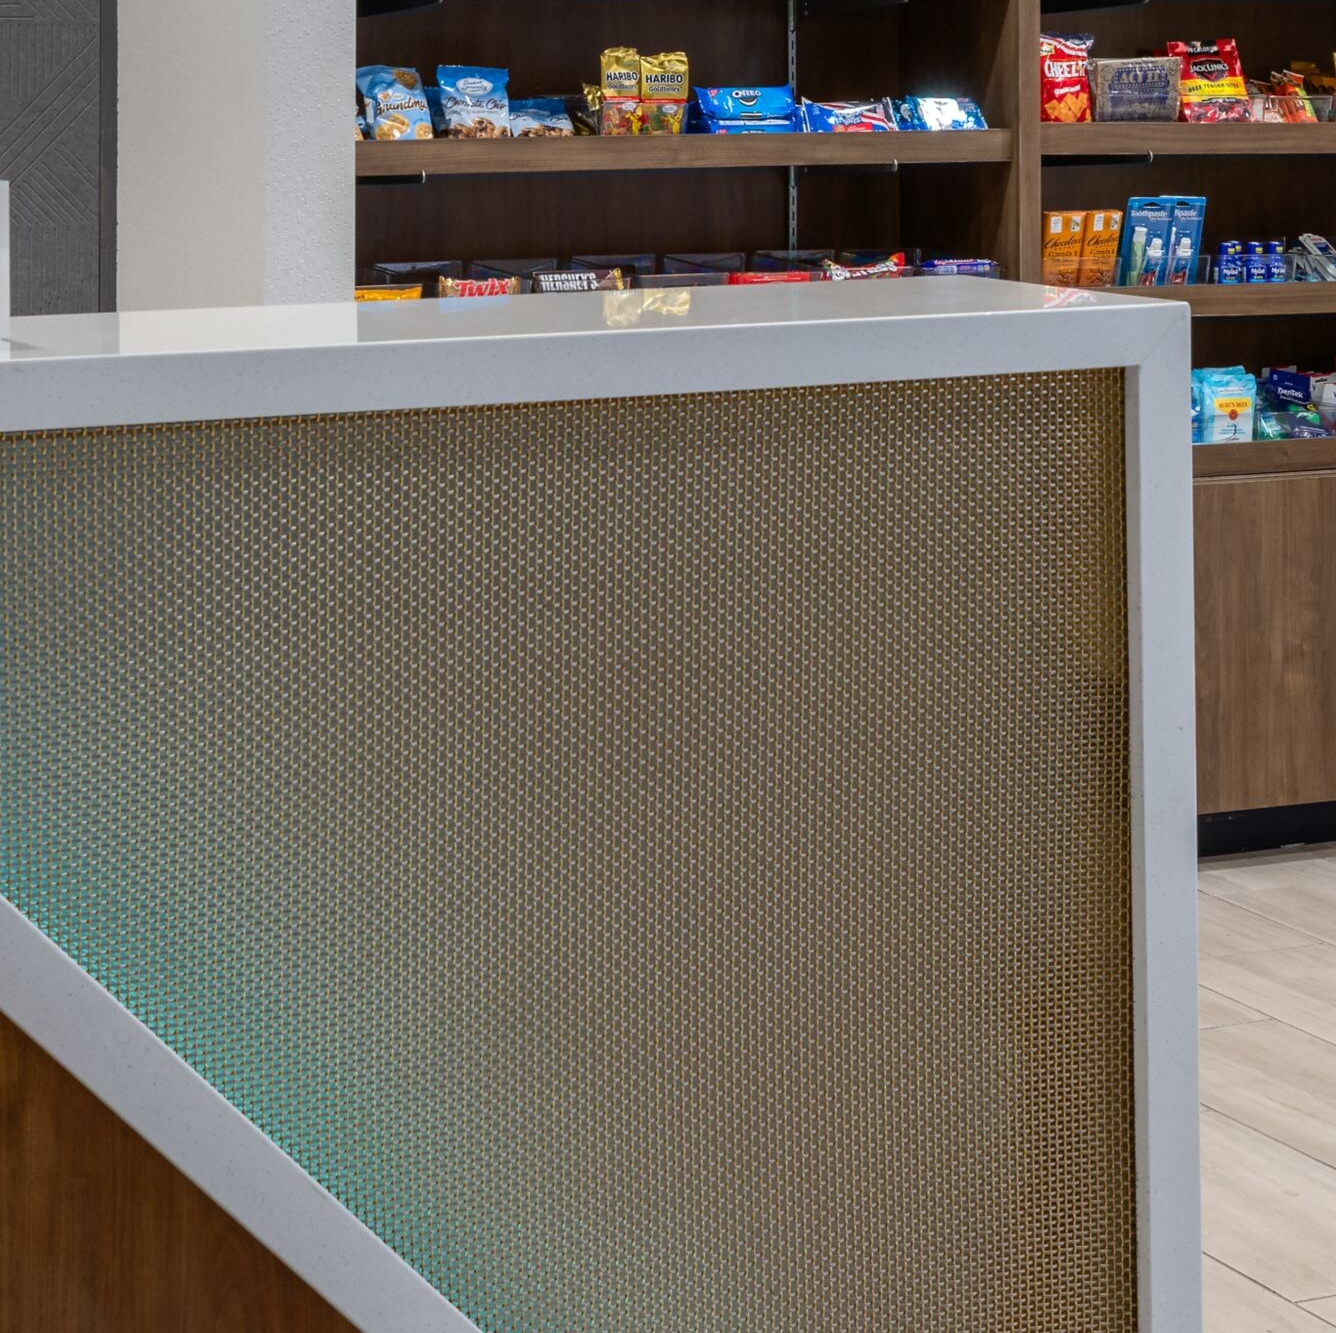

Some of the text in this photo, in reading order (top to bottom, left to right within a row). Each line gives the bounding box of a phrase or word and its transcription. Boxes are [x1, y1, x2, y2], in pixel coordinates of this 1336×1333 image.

[606, 71, 638, 82] HARIBO
[645, 74, 683, 84] HARIBO
[1131, 209, 1168, 219] Toothpaste
